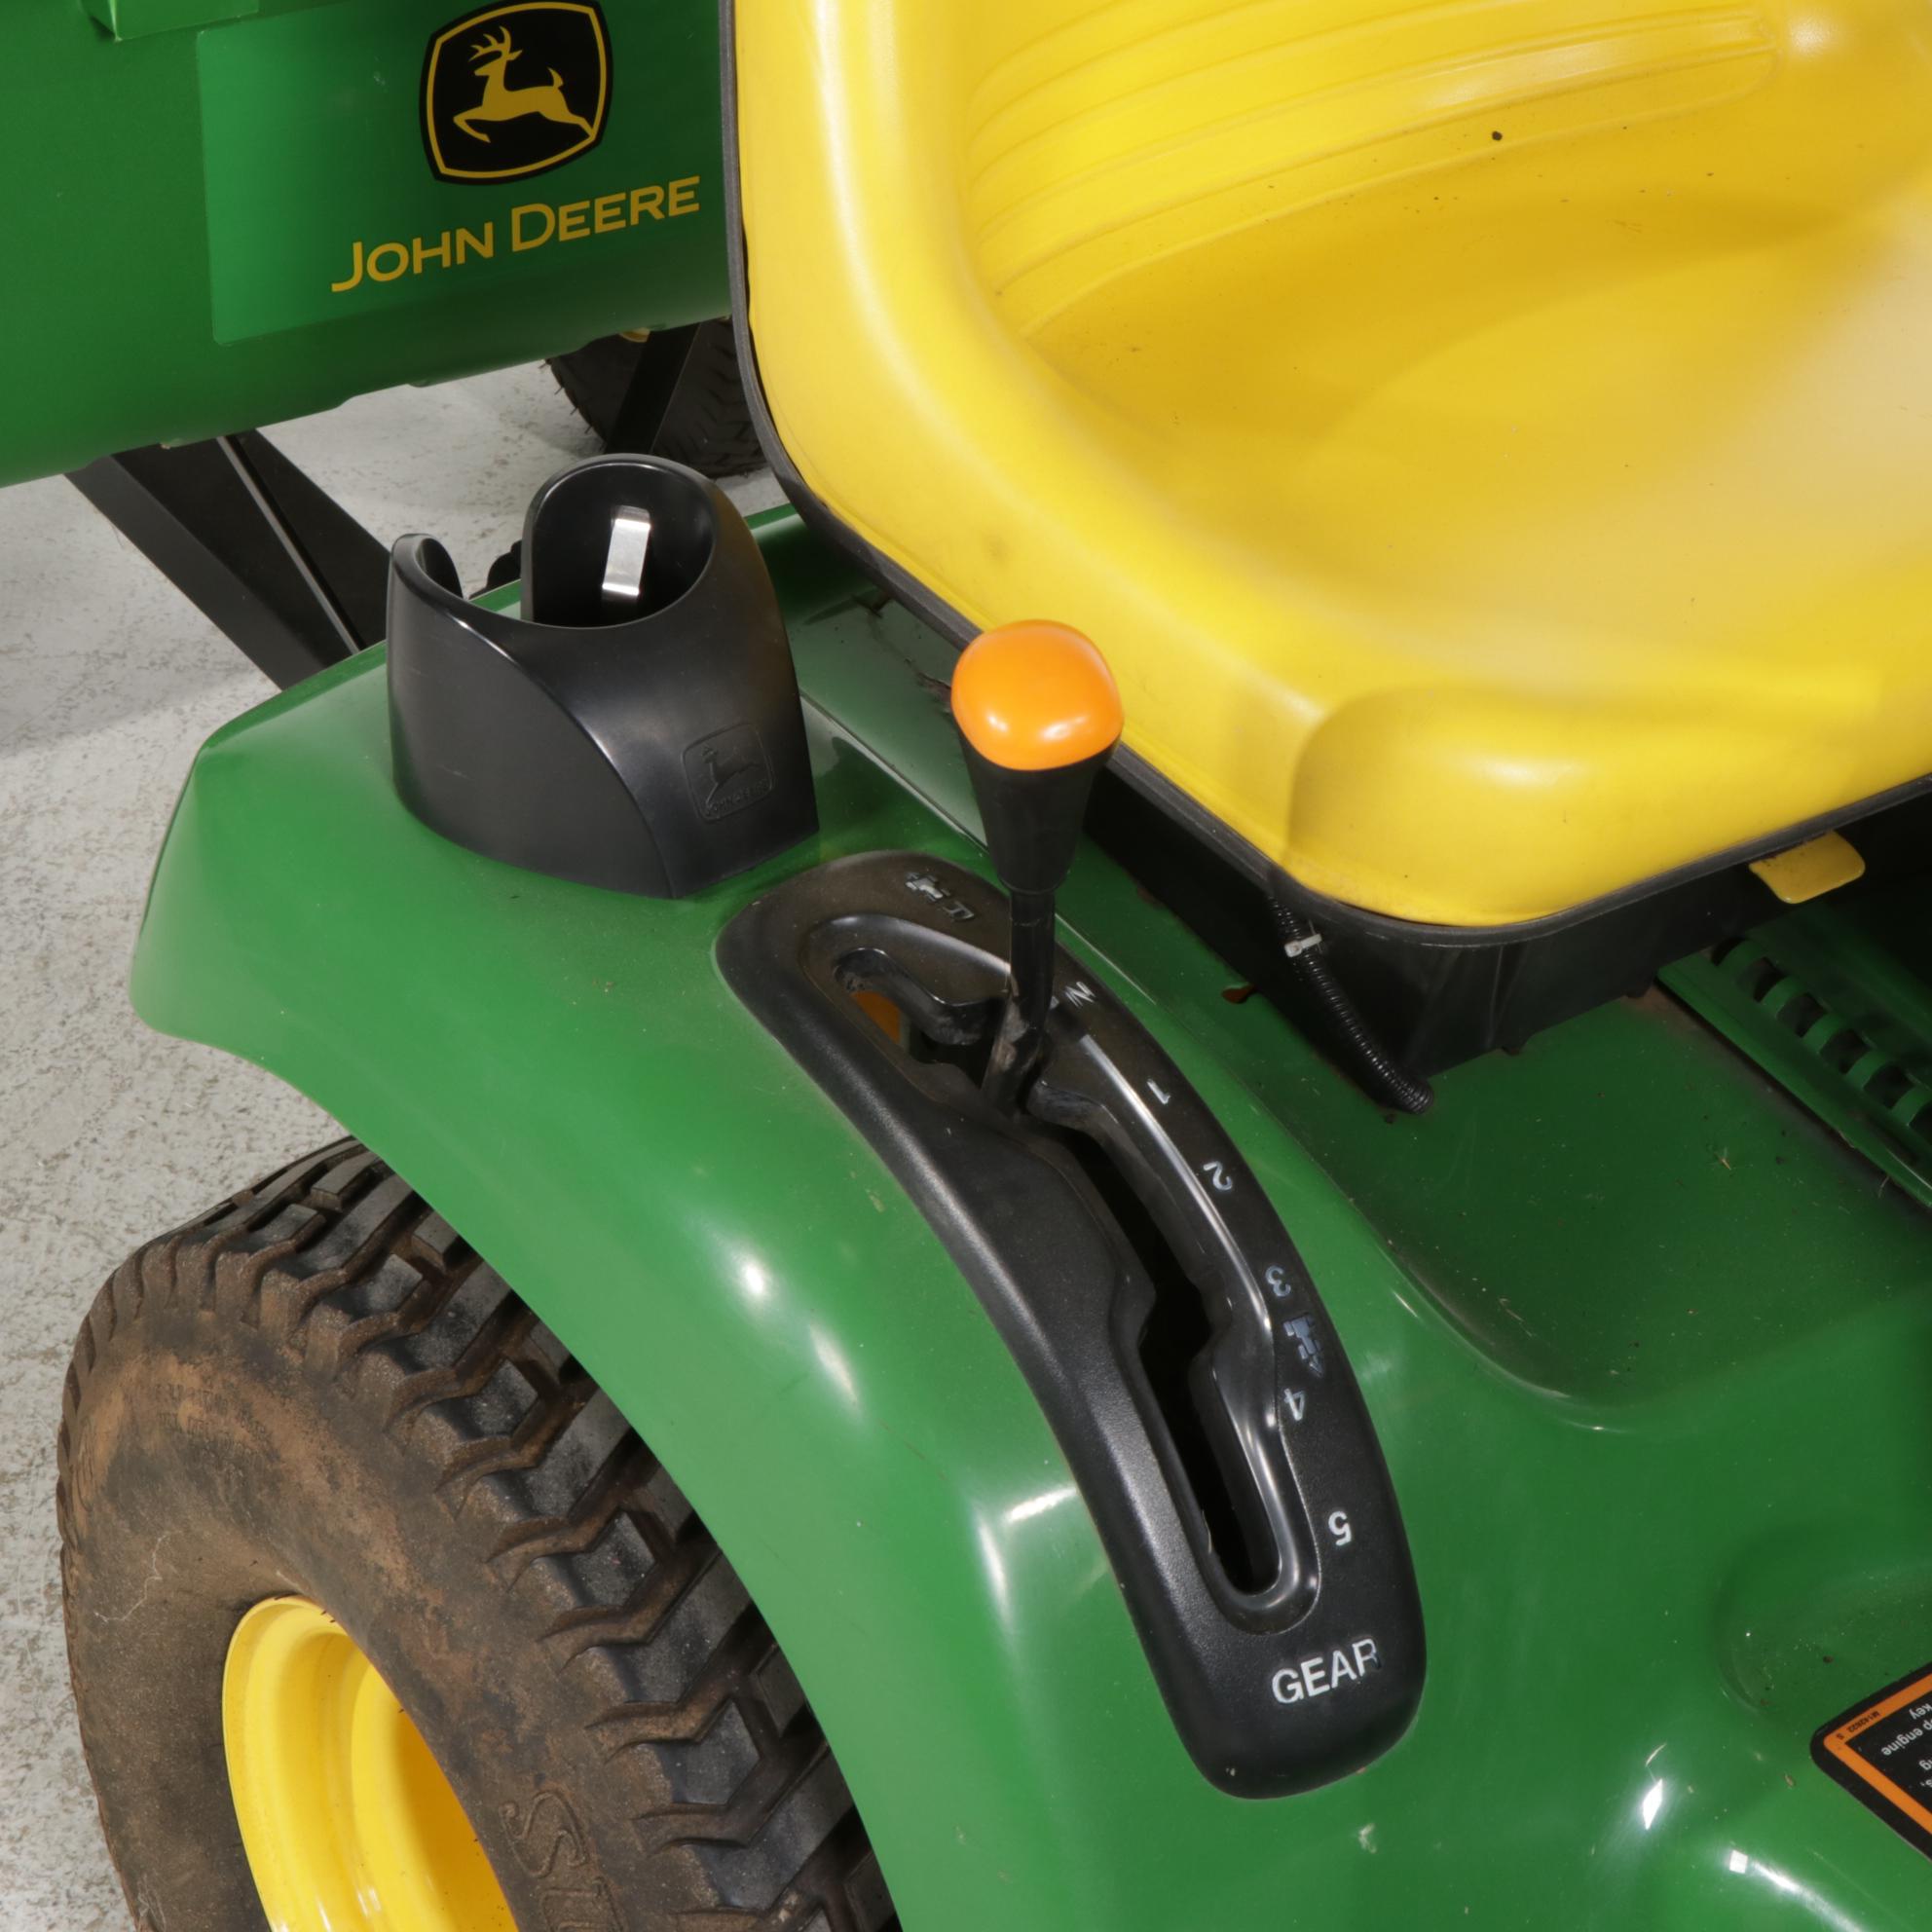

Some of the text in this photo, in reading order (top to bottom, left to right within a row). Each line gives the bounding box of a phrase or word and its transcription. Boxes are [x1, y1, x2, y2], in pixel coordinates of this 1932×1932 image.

[331, 175, 700, 292] JOHN DEERE
[1146, 1078, 1170, 1105] 1
[1202, 1161, 1233, 1191] 2
[1265, 1265, 1291, 1297] 3
[1282, 1387, 1306, 1422] 4
[1327, 1510, 1353, 1547] 5
[1271, 1637, 1383, 1705] GEAR
[1880, 1728, 1924, 1756] engine
